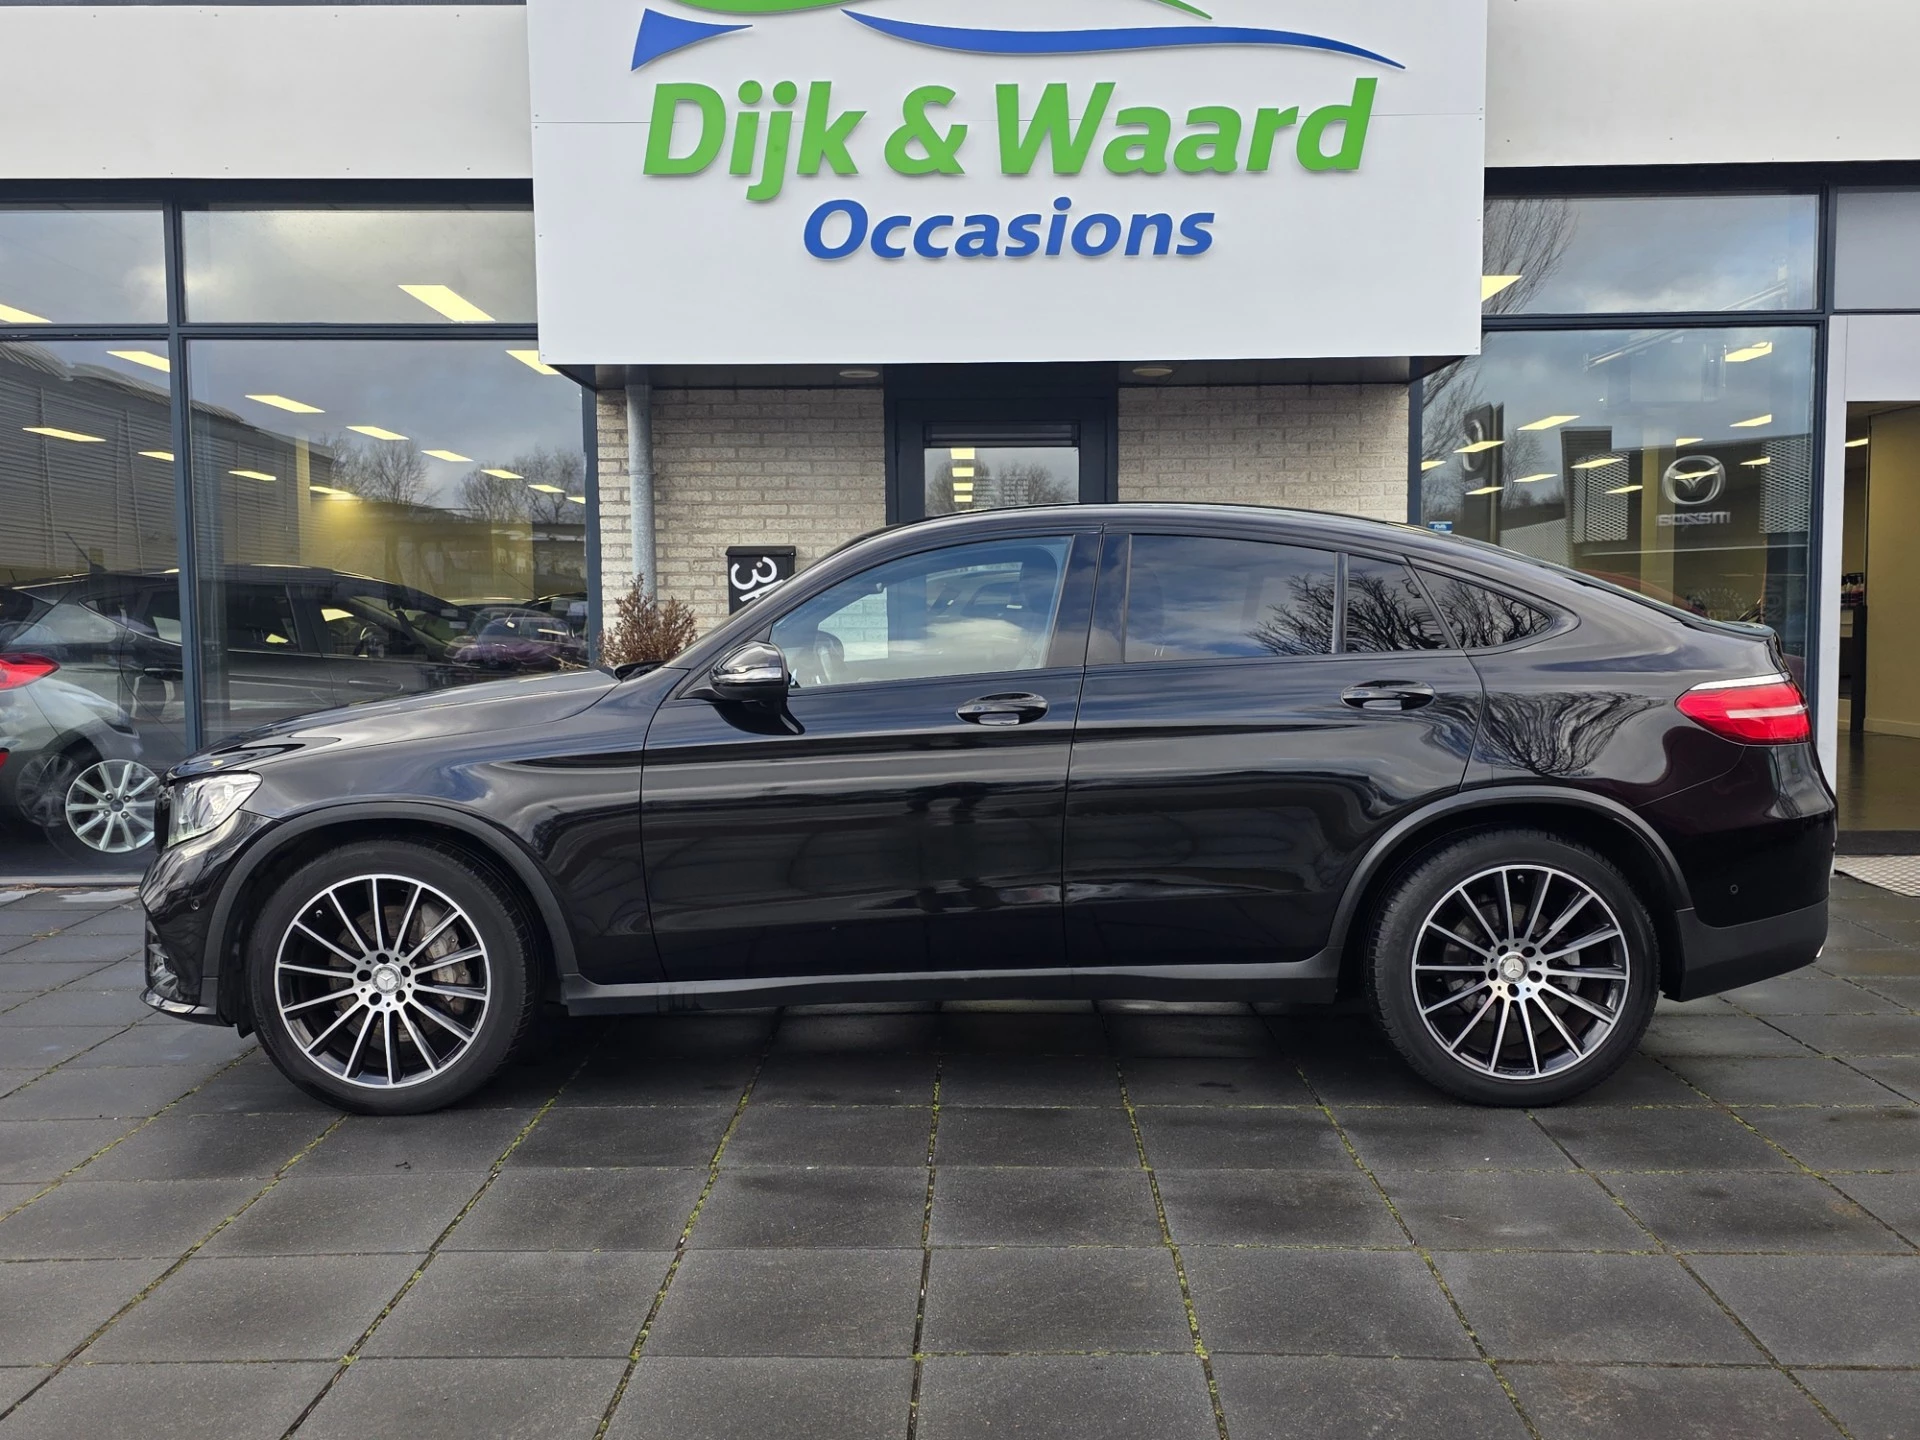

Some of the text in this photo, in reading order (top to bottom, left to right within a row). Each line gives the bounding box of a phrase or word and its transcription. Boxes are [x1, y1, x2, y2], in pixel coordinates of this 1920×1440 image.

[644, 78, 1377, 201] Dijk & Waard
[803, 197, 1214, 259] Occasions
